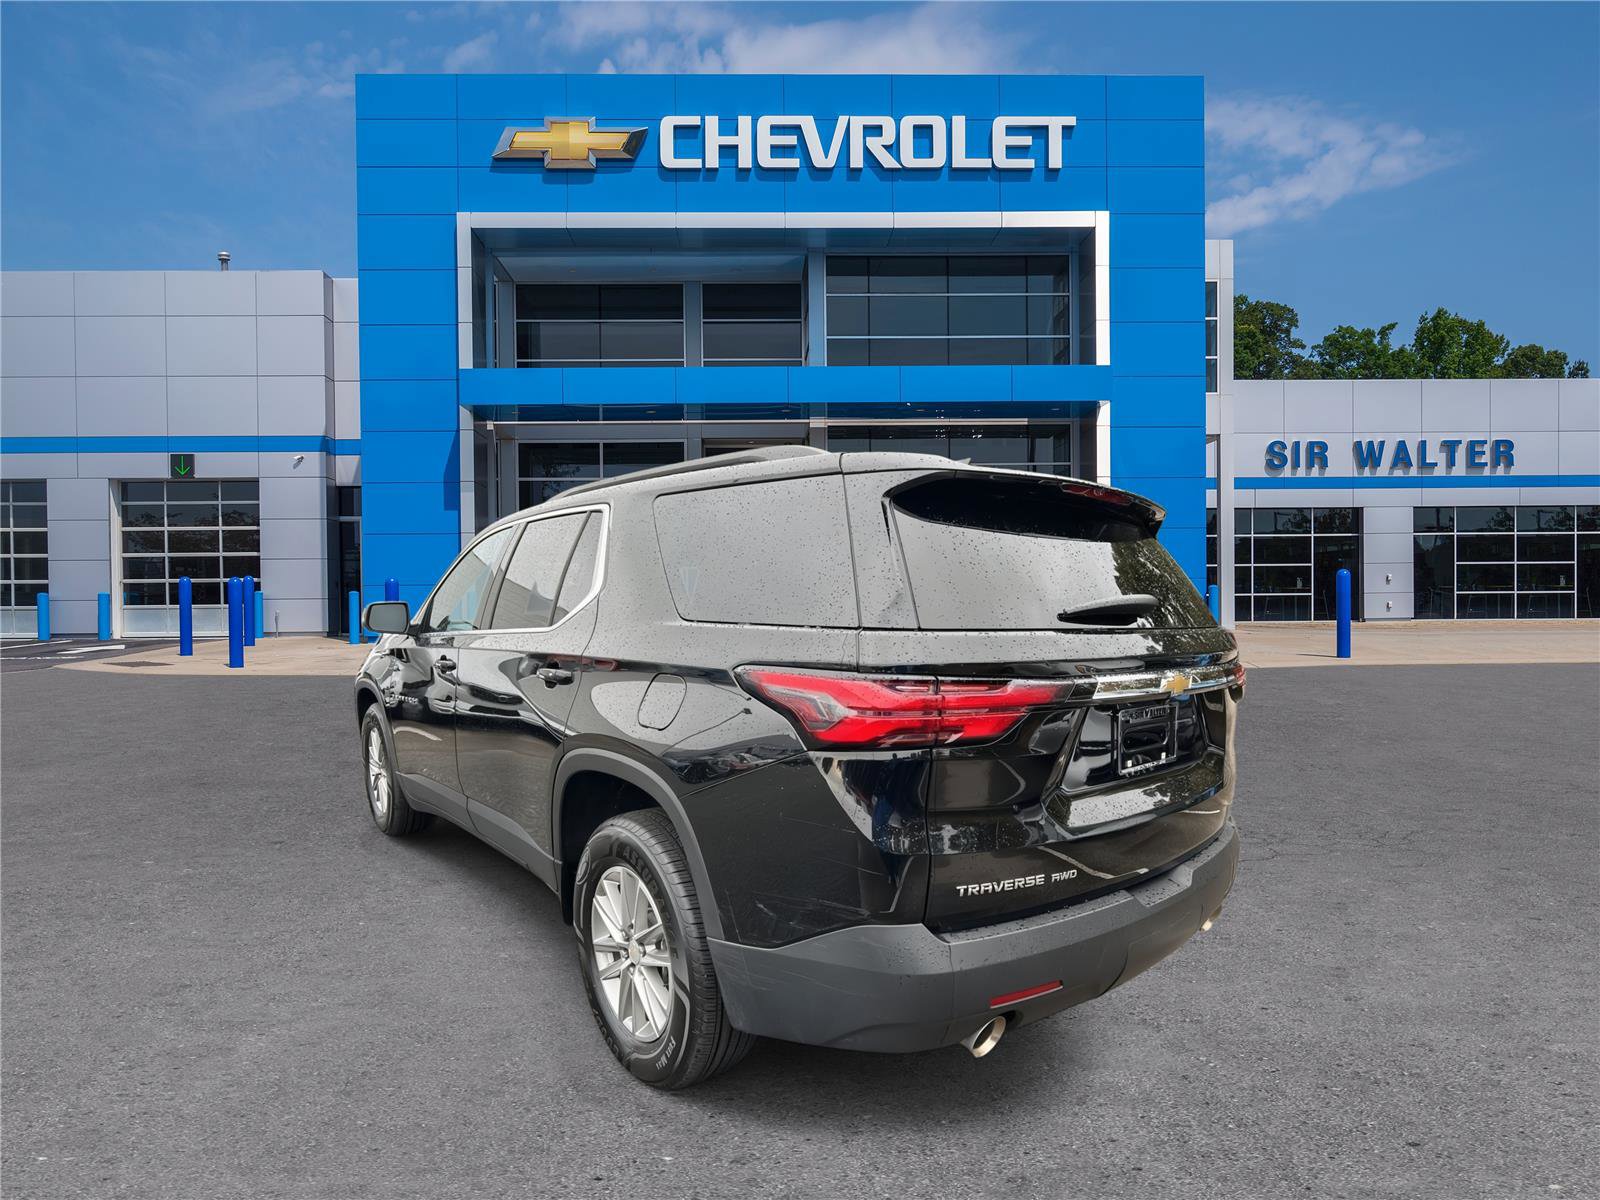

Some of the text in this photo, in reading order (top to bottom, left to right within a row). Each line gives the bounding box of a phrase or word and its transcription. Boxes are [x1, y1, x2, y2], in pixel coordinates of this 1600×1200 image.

[660, 115, 1076, 169] CHEVROLET
[1264, 439, 1515, 470] SIR WALTER
[956, 869, 1078, 897] TRAVERSE AWD
